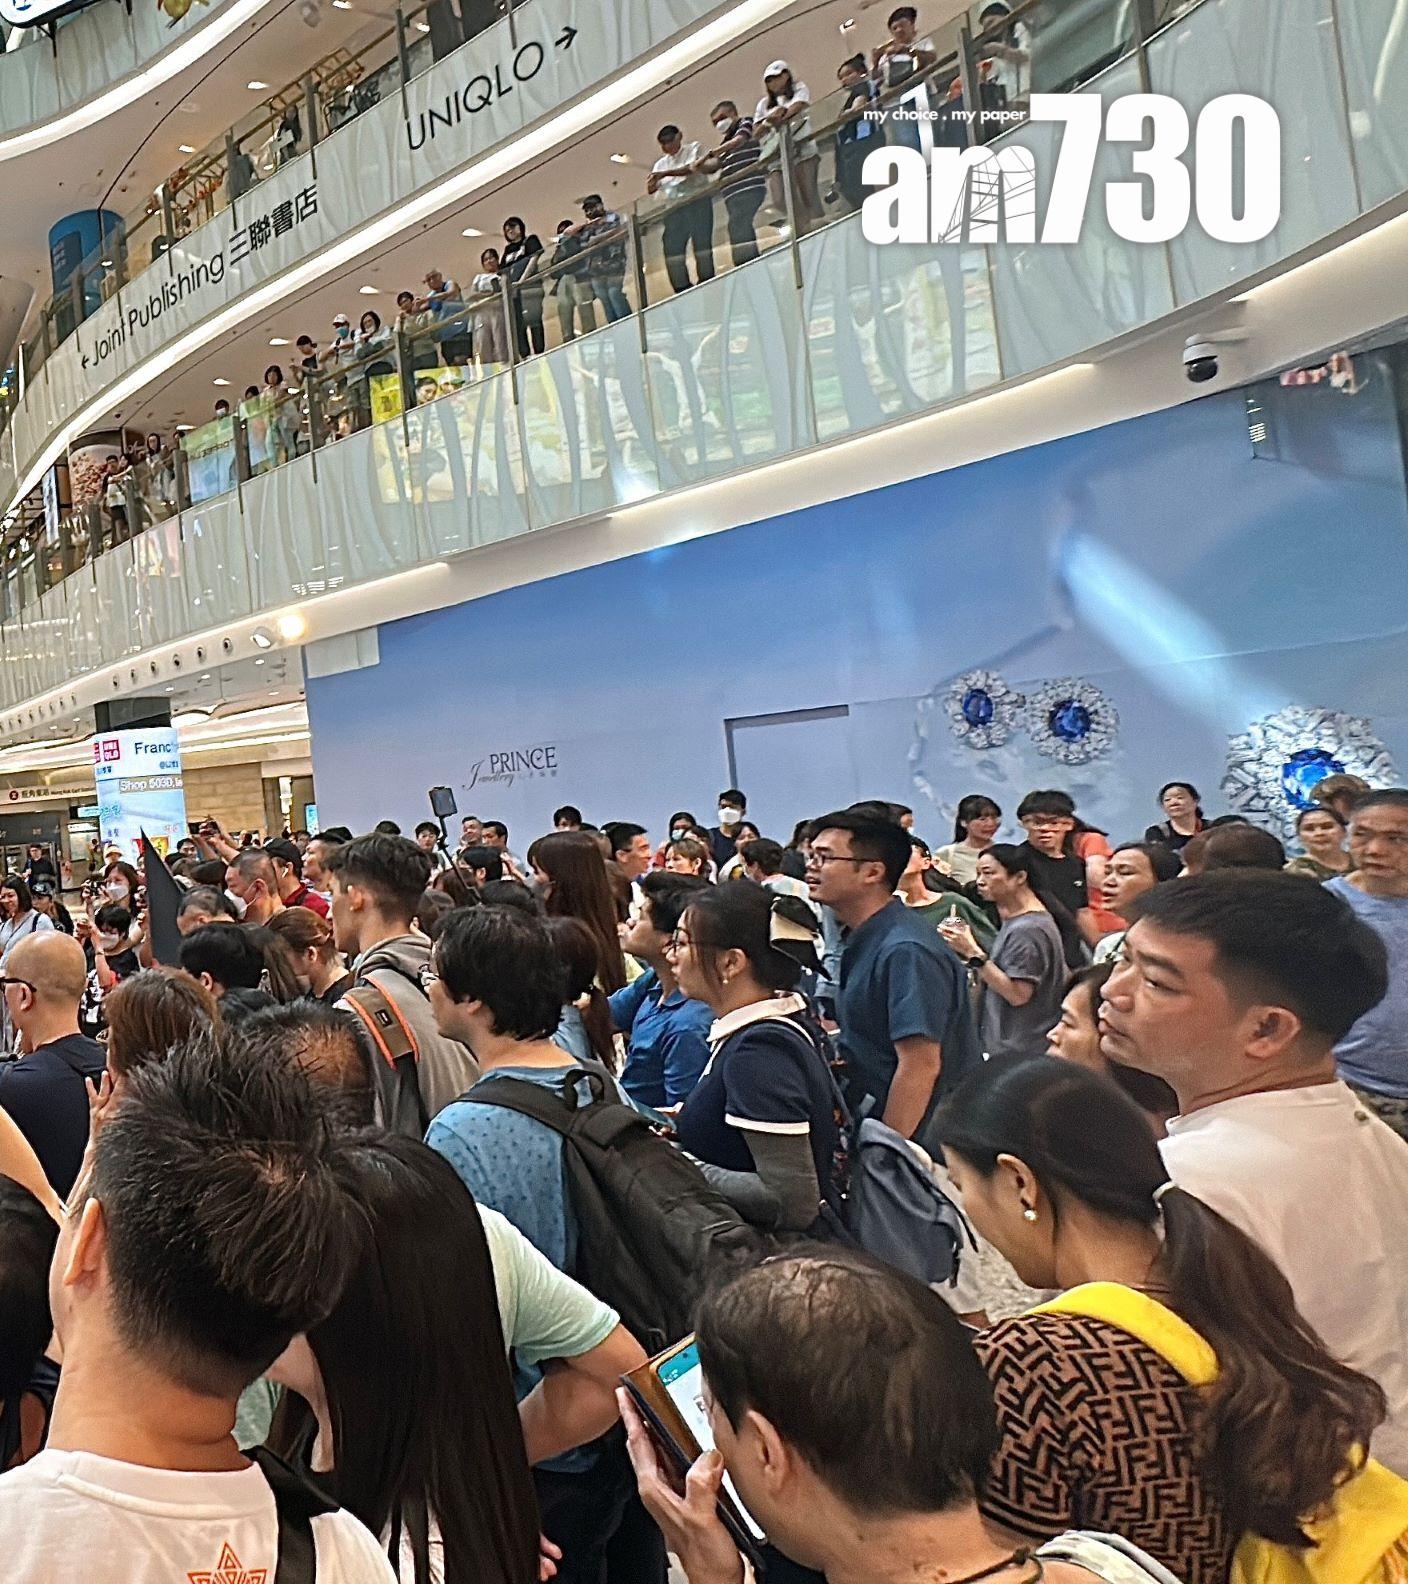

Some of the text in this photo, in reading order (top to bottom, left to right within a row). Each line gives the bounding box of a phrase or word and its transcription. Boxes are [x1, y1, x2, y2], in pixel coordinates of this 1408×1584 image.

[407, 42, 544, 150] UNIQLO
[93, 184, 318, 366] Joint Publishing 三聯書店
[119, 780, 147, 792] Shop
[490, 746, 558, 774] PRINCE
